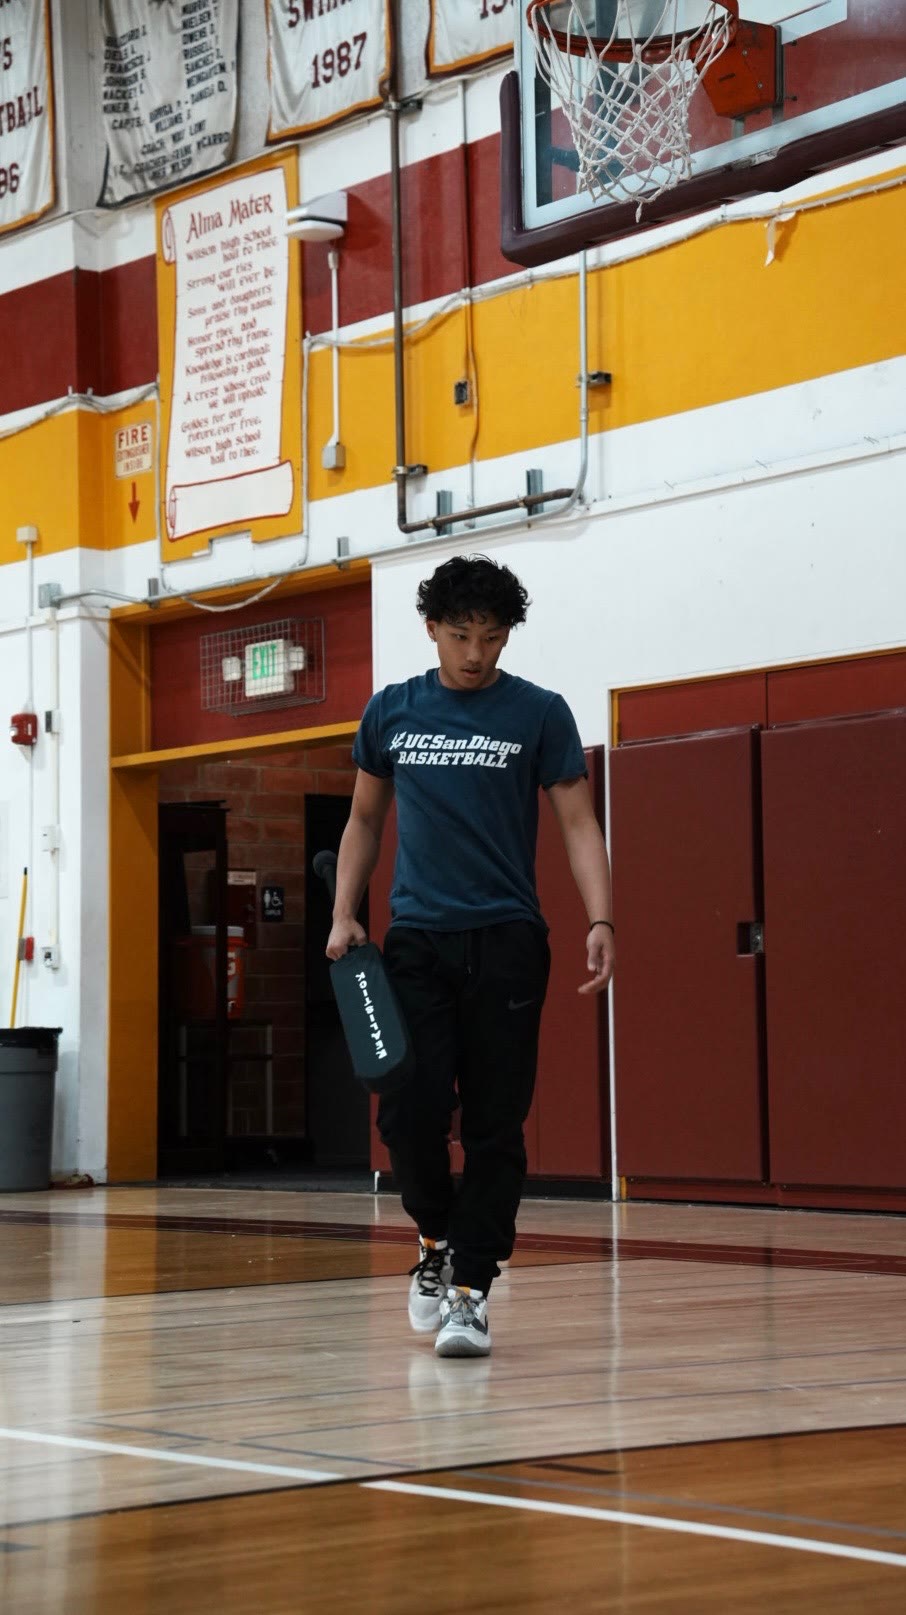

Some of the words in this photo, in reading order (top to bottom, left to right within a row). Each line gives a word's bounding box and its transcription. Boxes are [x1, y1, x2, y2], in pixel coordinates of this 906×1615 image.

[311, 31, 367, 89] 1987
[186, 210, 223, 244] Alma
[118, 424, 148, 449] FIRE
[252, 642, 277, 680] EXIT
[397, 751, 508, 768] BASKETBALL
